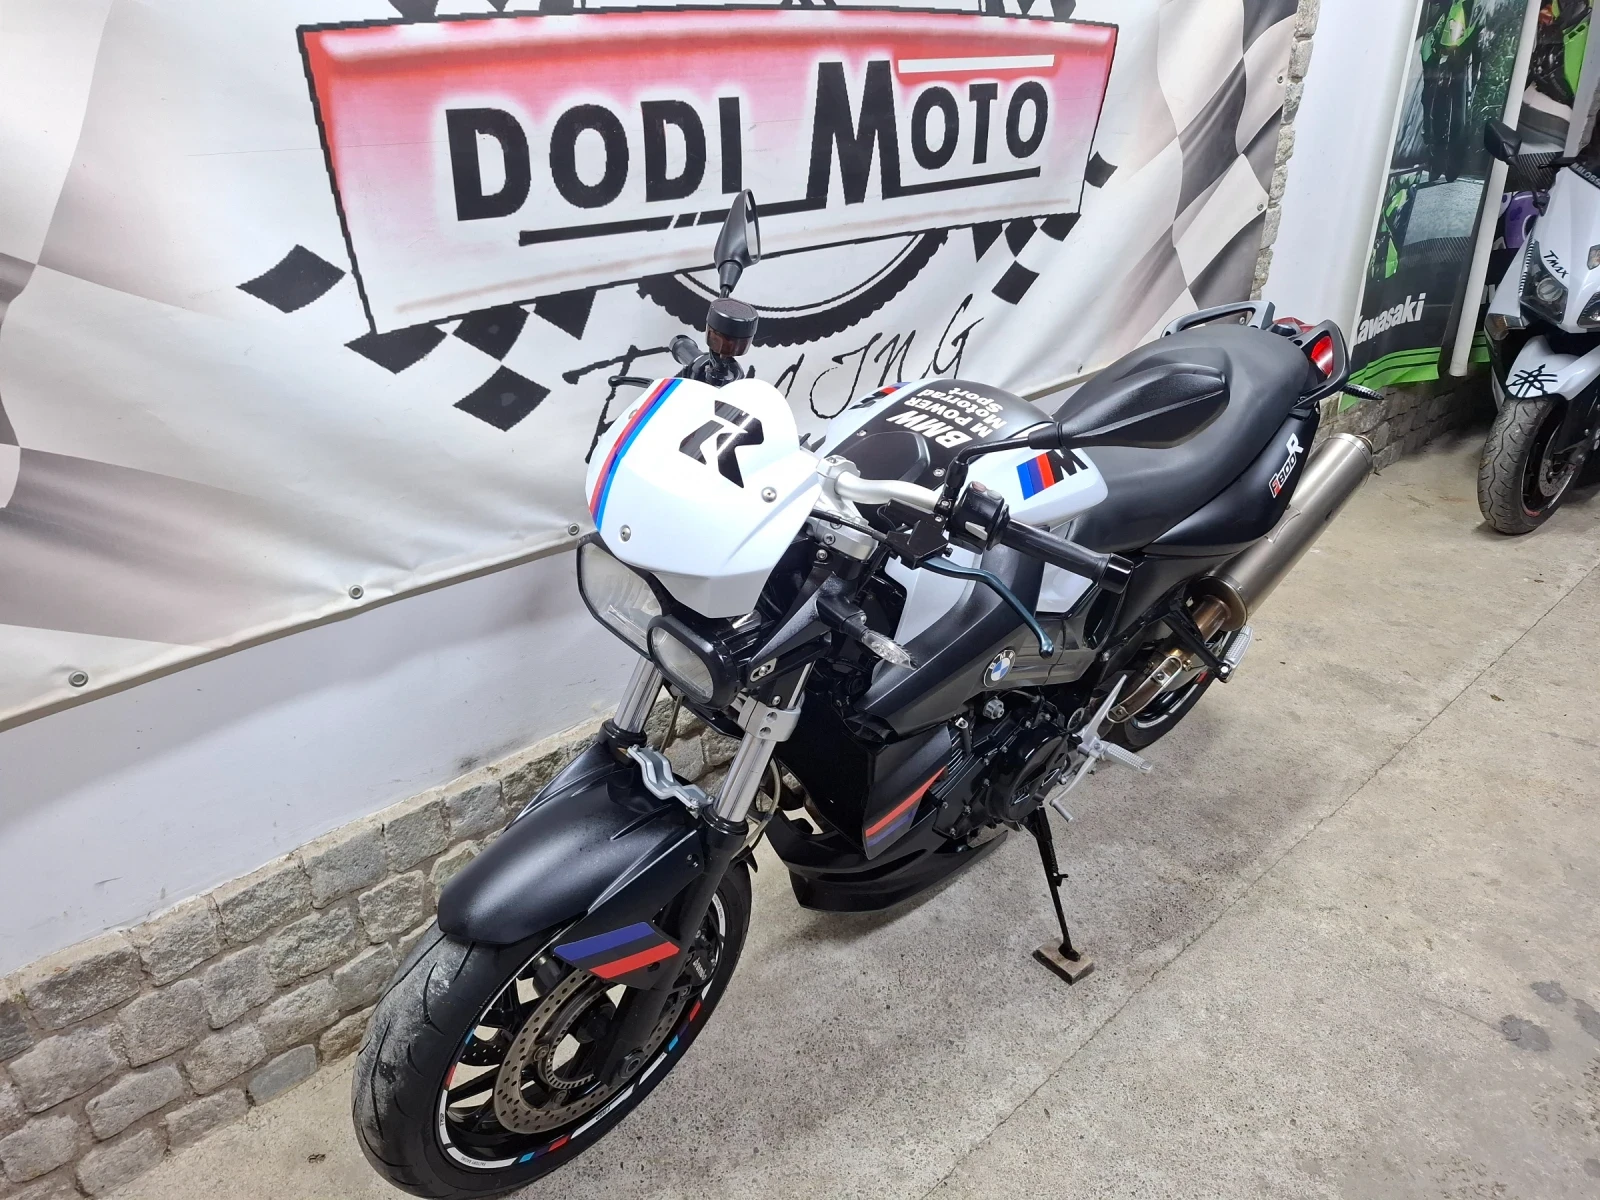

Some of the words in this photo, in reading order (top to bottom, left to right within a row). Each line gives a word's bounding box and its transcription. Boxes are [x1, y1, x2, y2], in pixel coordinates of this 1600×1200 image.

[446, 96, 743, 221] DODI
[805, 60, 1048, 205] MOTO
[903, 396, 973, 426] POWER
[917, 388, 1007, 430] Motorrad
[948, 387, 1003, 413] Sport
[886, 410, 973, 449] BMW
[969, 422, 993, 438] M
